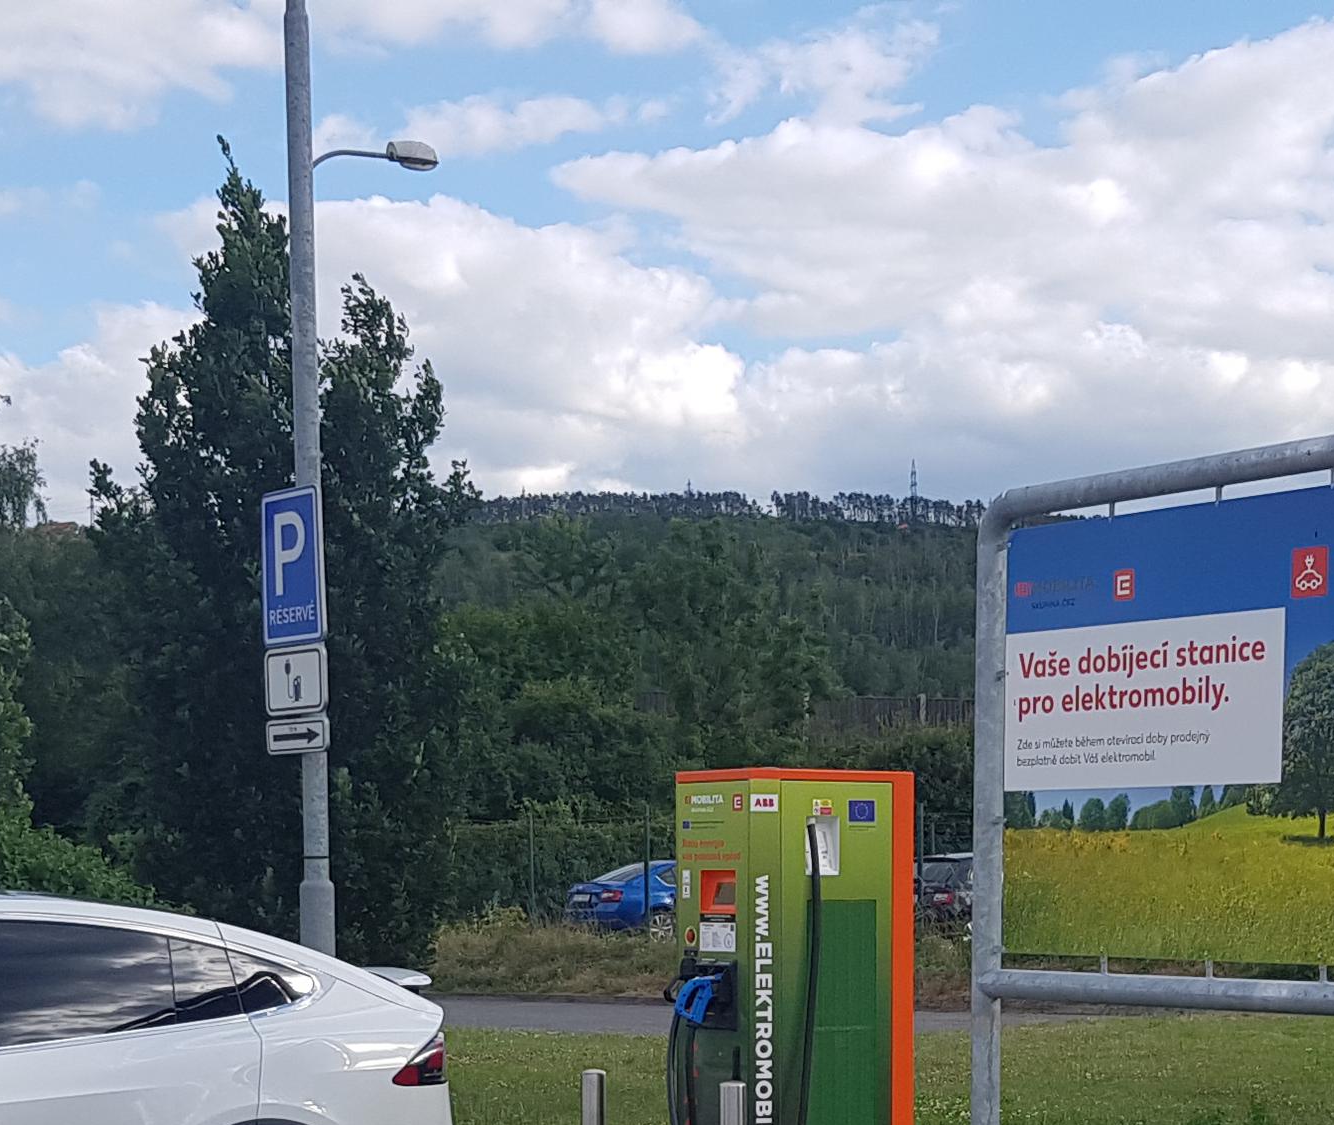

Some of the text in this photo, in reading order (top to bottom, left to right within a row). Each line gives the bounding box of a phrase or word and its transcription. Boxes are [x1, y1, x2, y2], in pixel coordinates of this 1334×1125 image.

[273, 511, 305, 597] P
[269, 600, 316, 625] RÉSERVÉ
[1018, 635, 1266, 679] Vaše dobíjecí stanice
[1018, 675, 1230, 722] pro elektromobily.
[1017, 739, 1033, 750] Zde
[1146, 732, 1168, 746] doby
[754, 798, 775, 808] ABB
